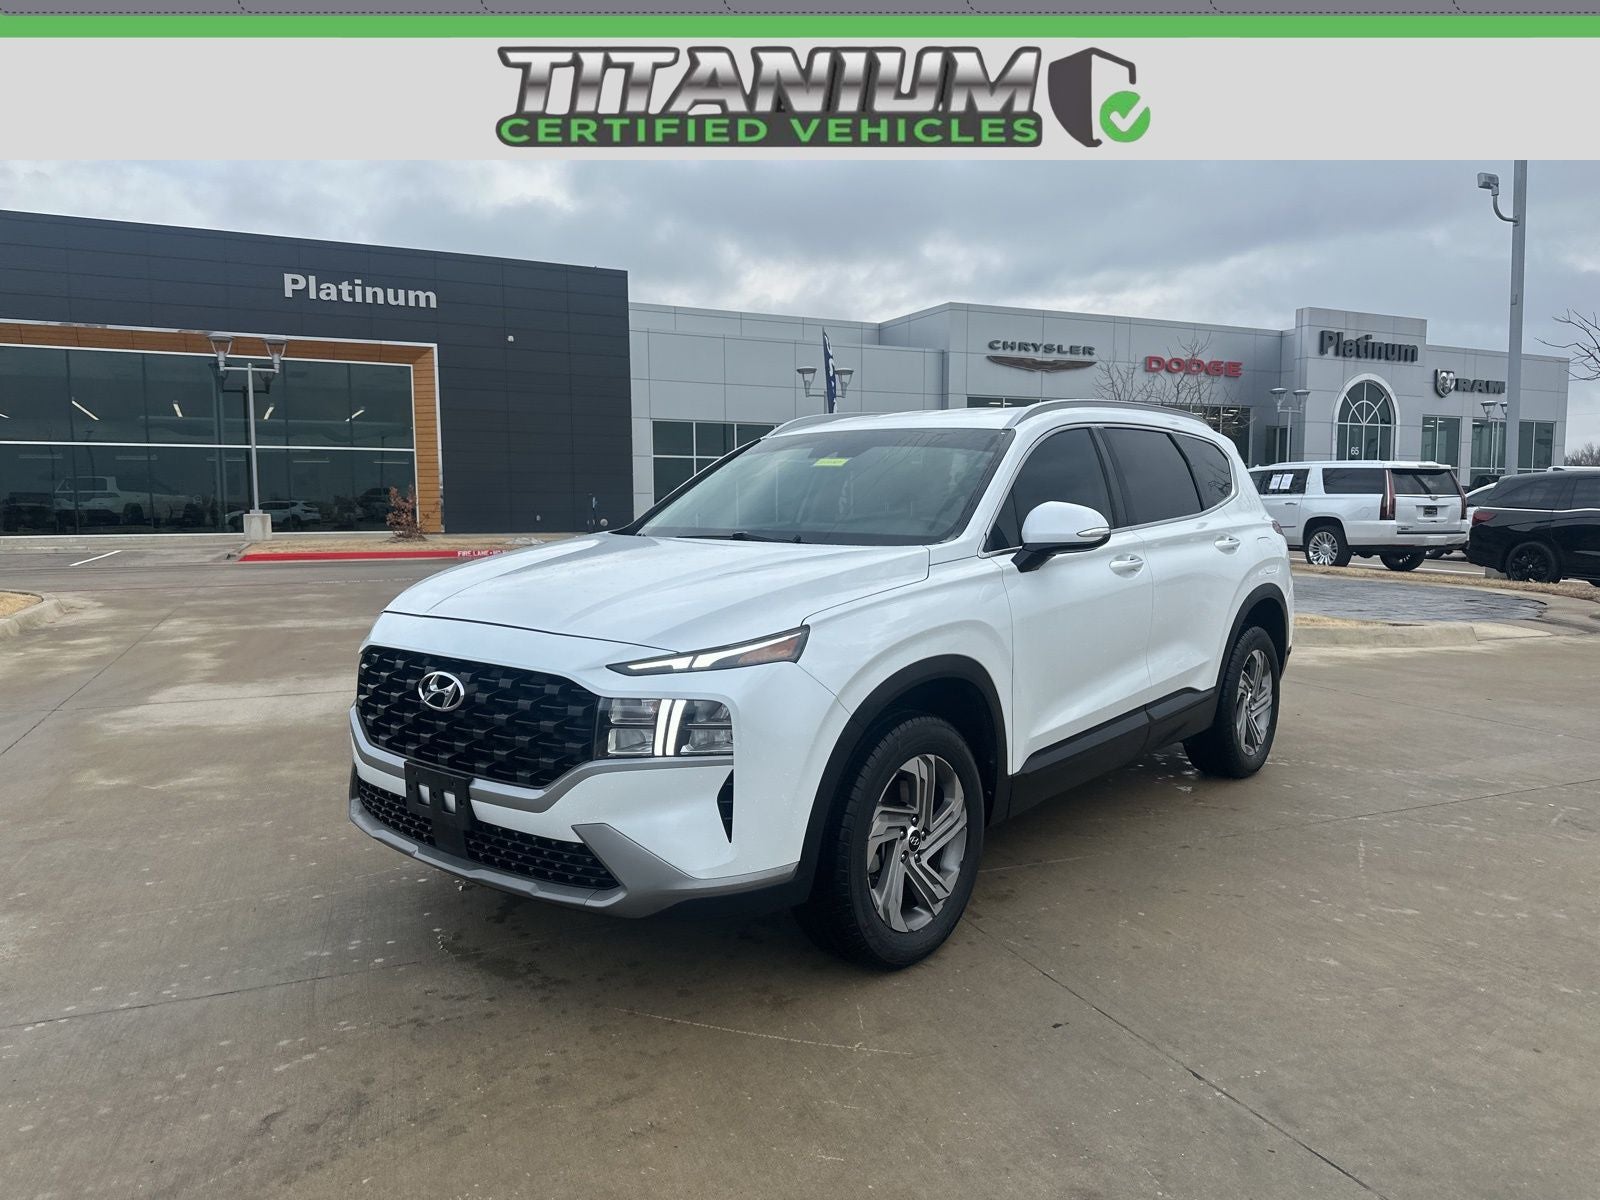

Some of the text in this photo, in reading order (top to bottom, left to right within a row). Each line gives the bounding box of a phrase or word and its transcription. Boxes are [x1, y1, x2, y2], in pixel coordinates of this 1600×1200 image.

[283, 273, 437, 309] Platinum
[987, 339, 1096, 356] CHRYSLER
[1319, 330, 1419, 362] Platinum
[1144, 355, 1243, 378] DODGE
[1454, 378, 1506, 394] RAM
